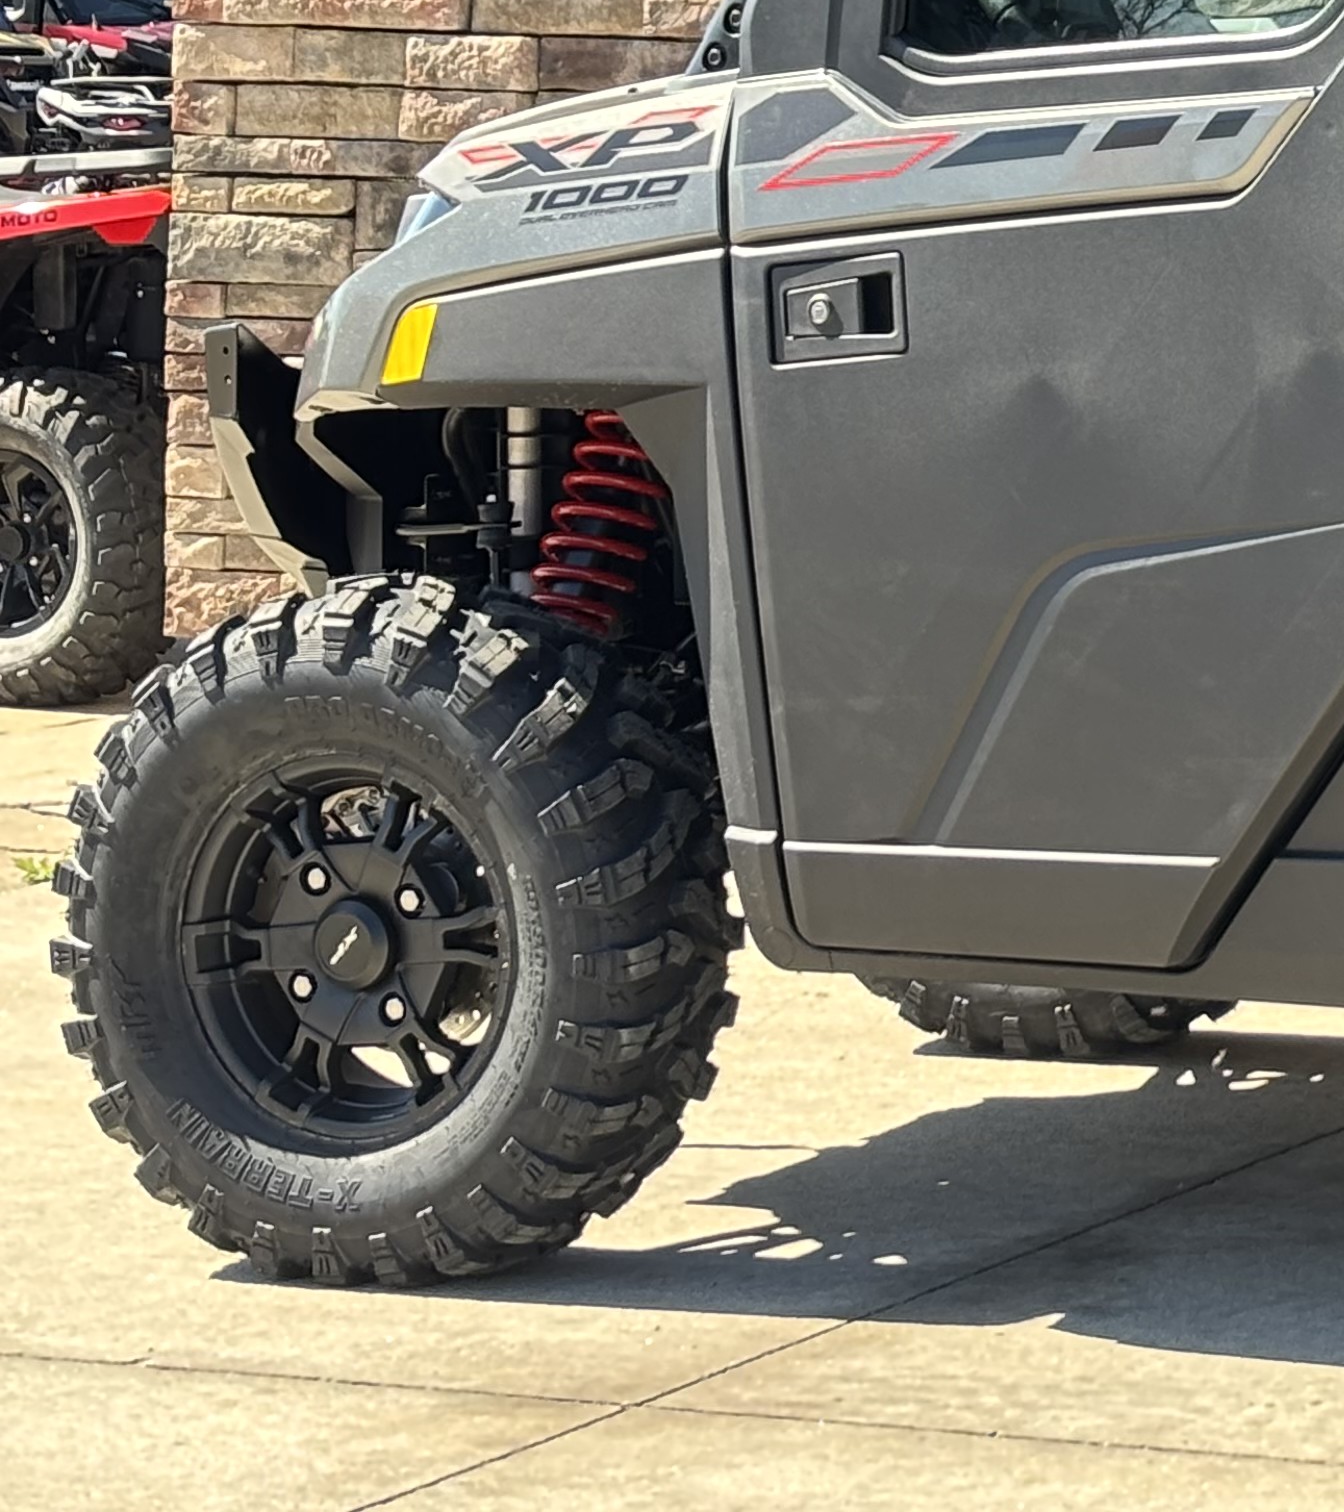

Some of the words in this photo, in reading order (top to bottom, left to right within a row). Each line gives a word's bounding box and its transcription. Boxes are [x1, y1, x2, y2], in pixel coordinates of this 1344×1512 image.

[470, 120, 701, 182] XP
[1, 209, 57, 228] MOTO
[524, 174, 689, 213] 1000
[166, 1097, 362, 1211] X-TERRAIN
